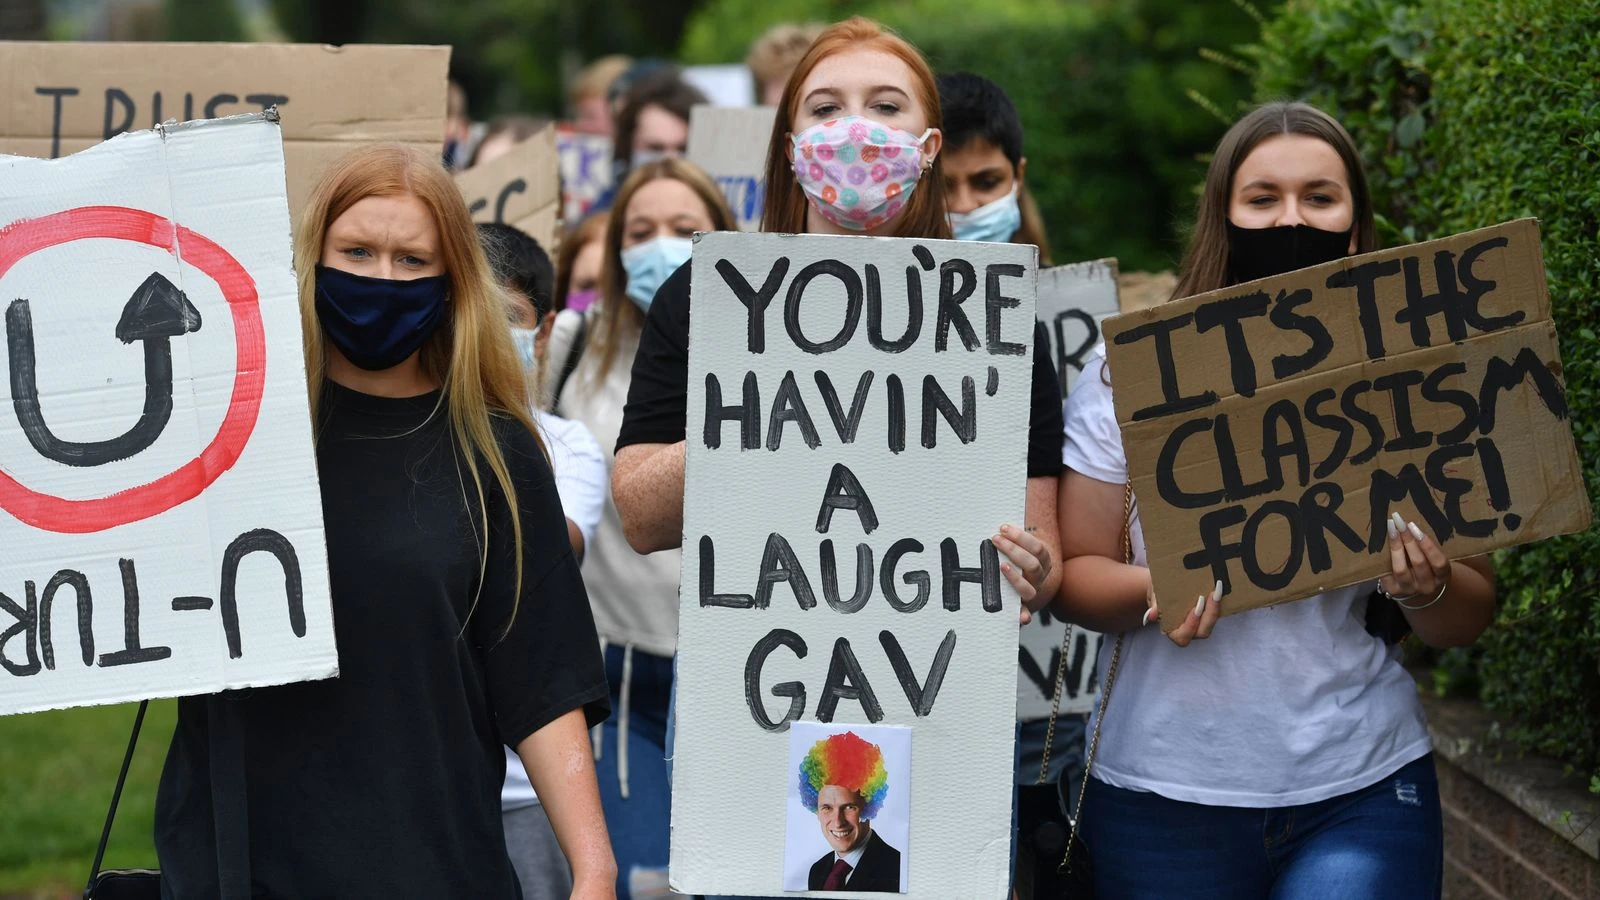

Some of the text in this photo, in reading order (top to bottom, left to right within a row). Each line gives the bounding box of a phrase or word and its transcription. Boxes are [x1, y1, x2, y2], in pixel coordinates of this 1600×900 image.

[715, 245, 1026, 355] YOU'RE
[1114, 237, 1526, 421] IT'S THE
[703, 366, 999, 454] HAVIN'
[1156, 347, 1568, 509] CLASSISM
[815, 463, 879, 534] A
[1183, 437, 1522, 595] FOR ME!
[699, 532, 1003, 614] LAUGH
[744, 628, 957, 733] GAV
